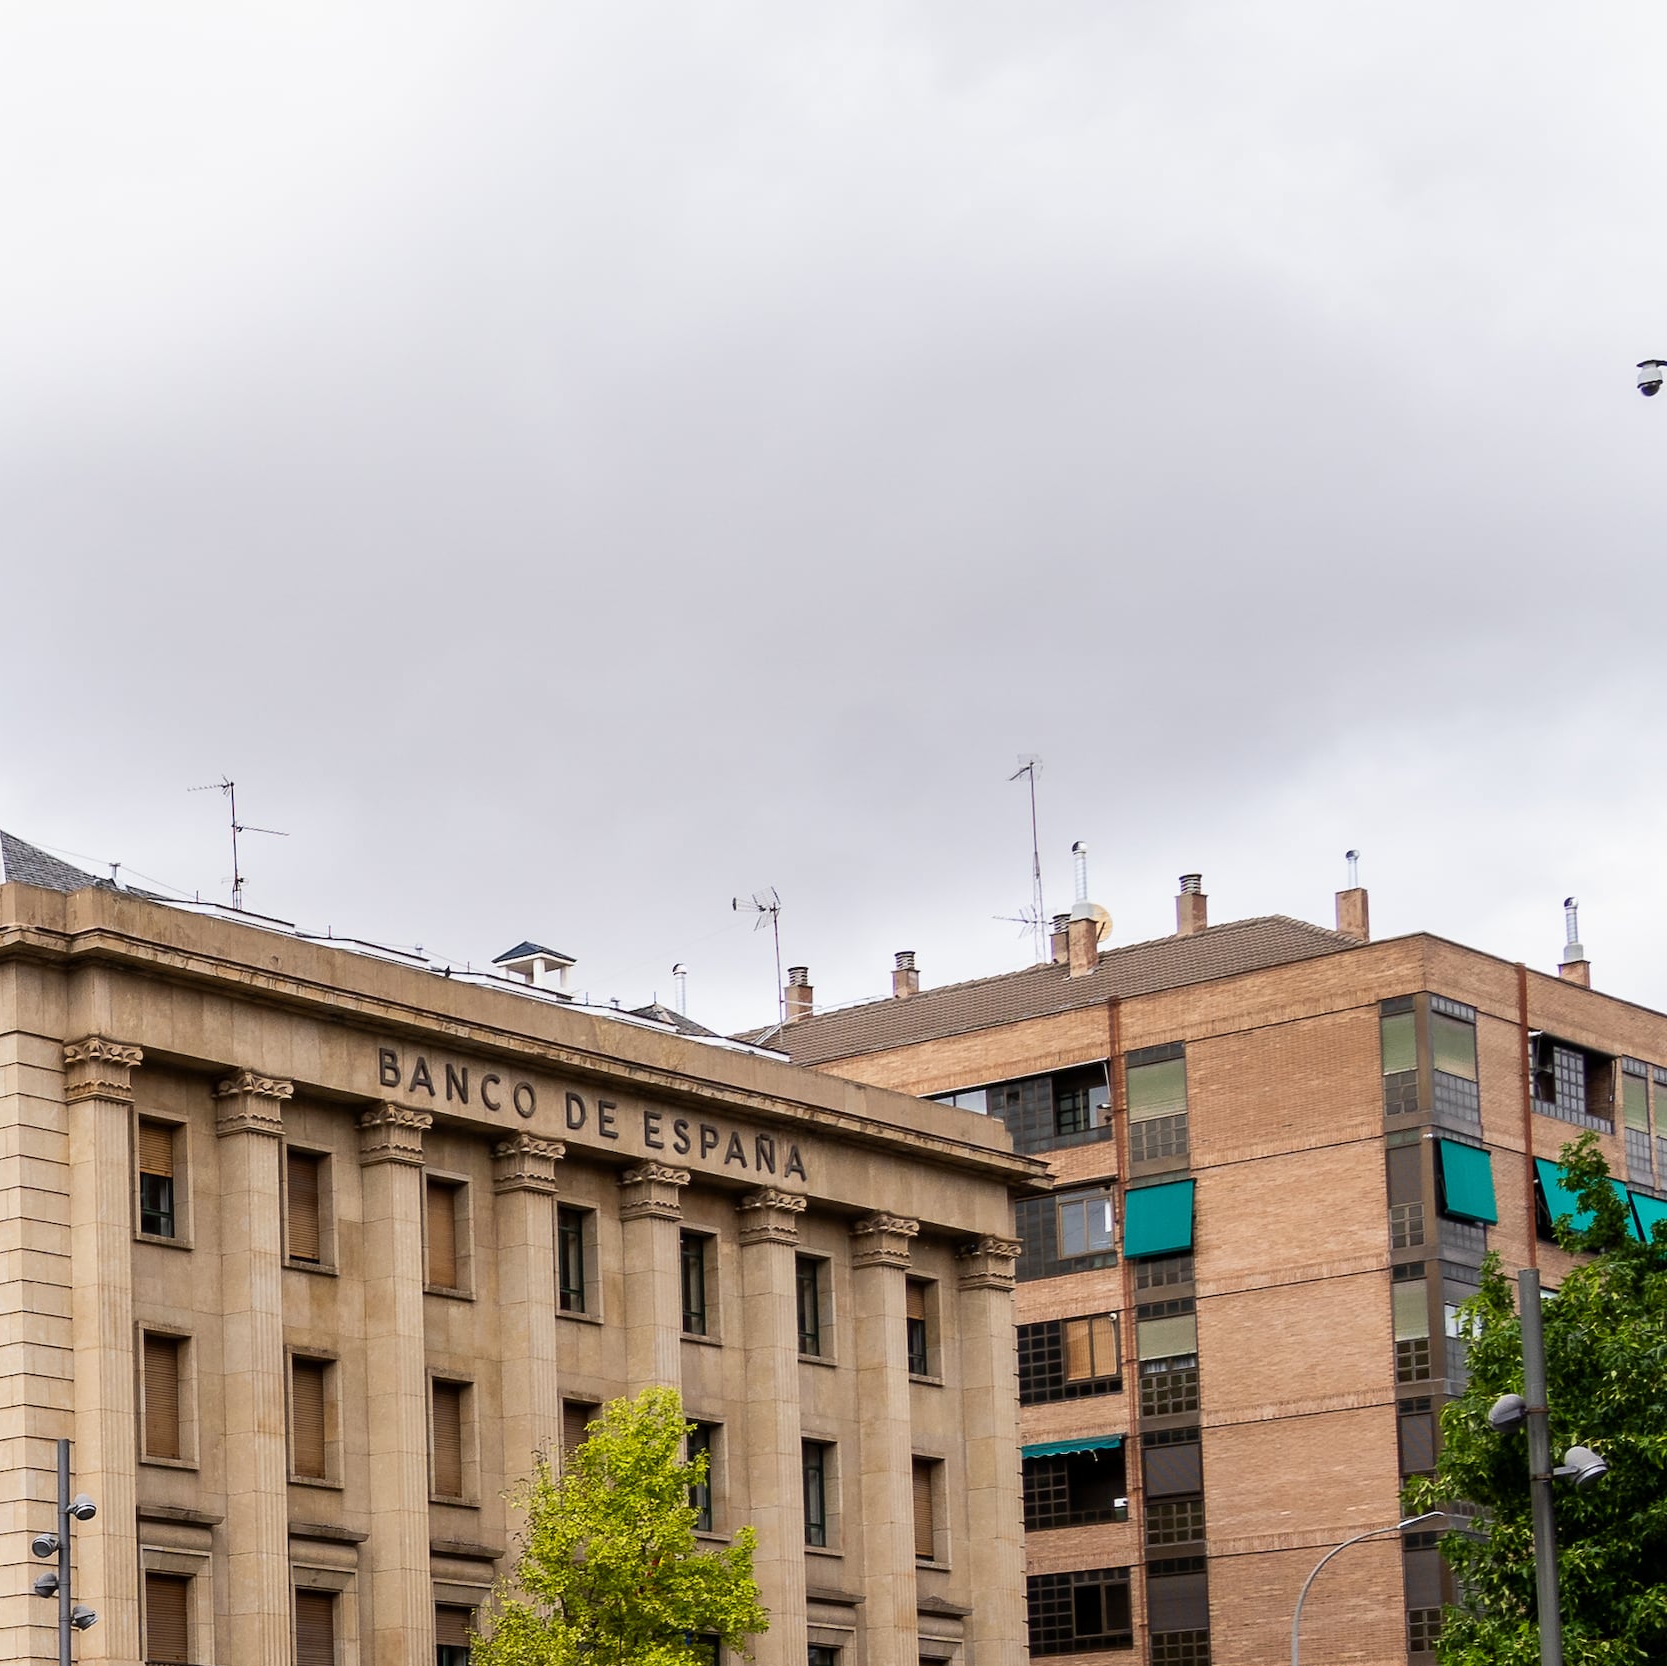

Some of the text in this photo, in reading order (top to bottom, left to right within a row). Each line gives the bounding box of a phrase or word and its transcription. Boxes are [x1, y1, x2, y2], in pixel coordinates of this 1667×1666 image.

[378, 1047, 808, 1182] BANCO DE ESPAÑA
